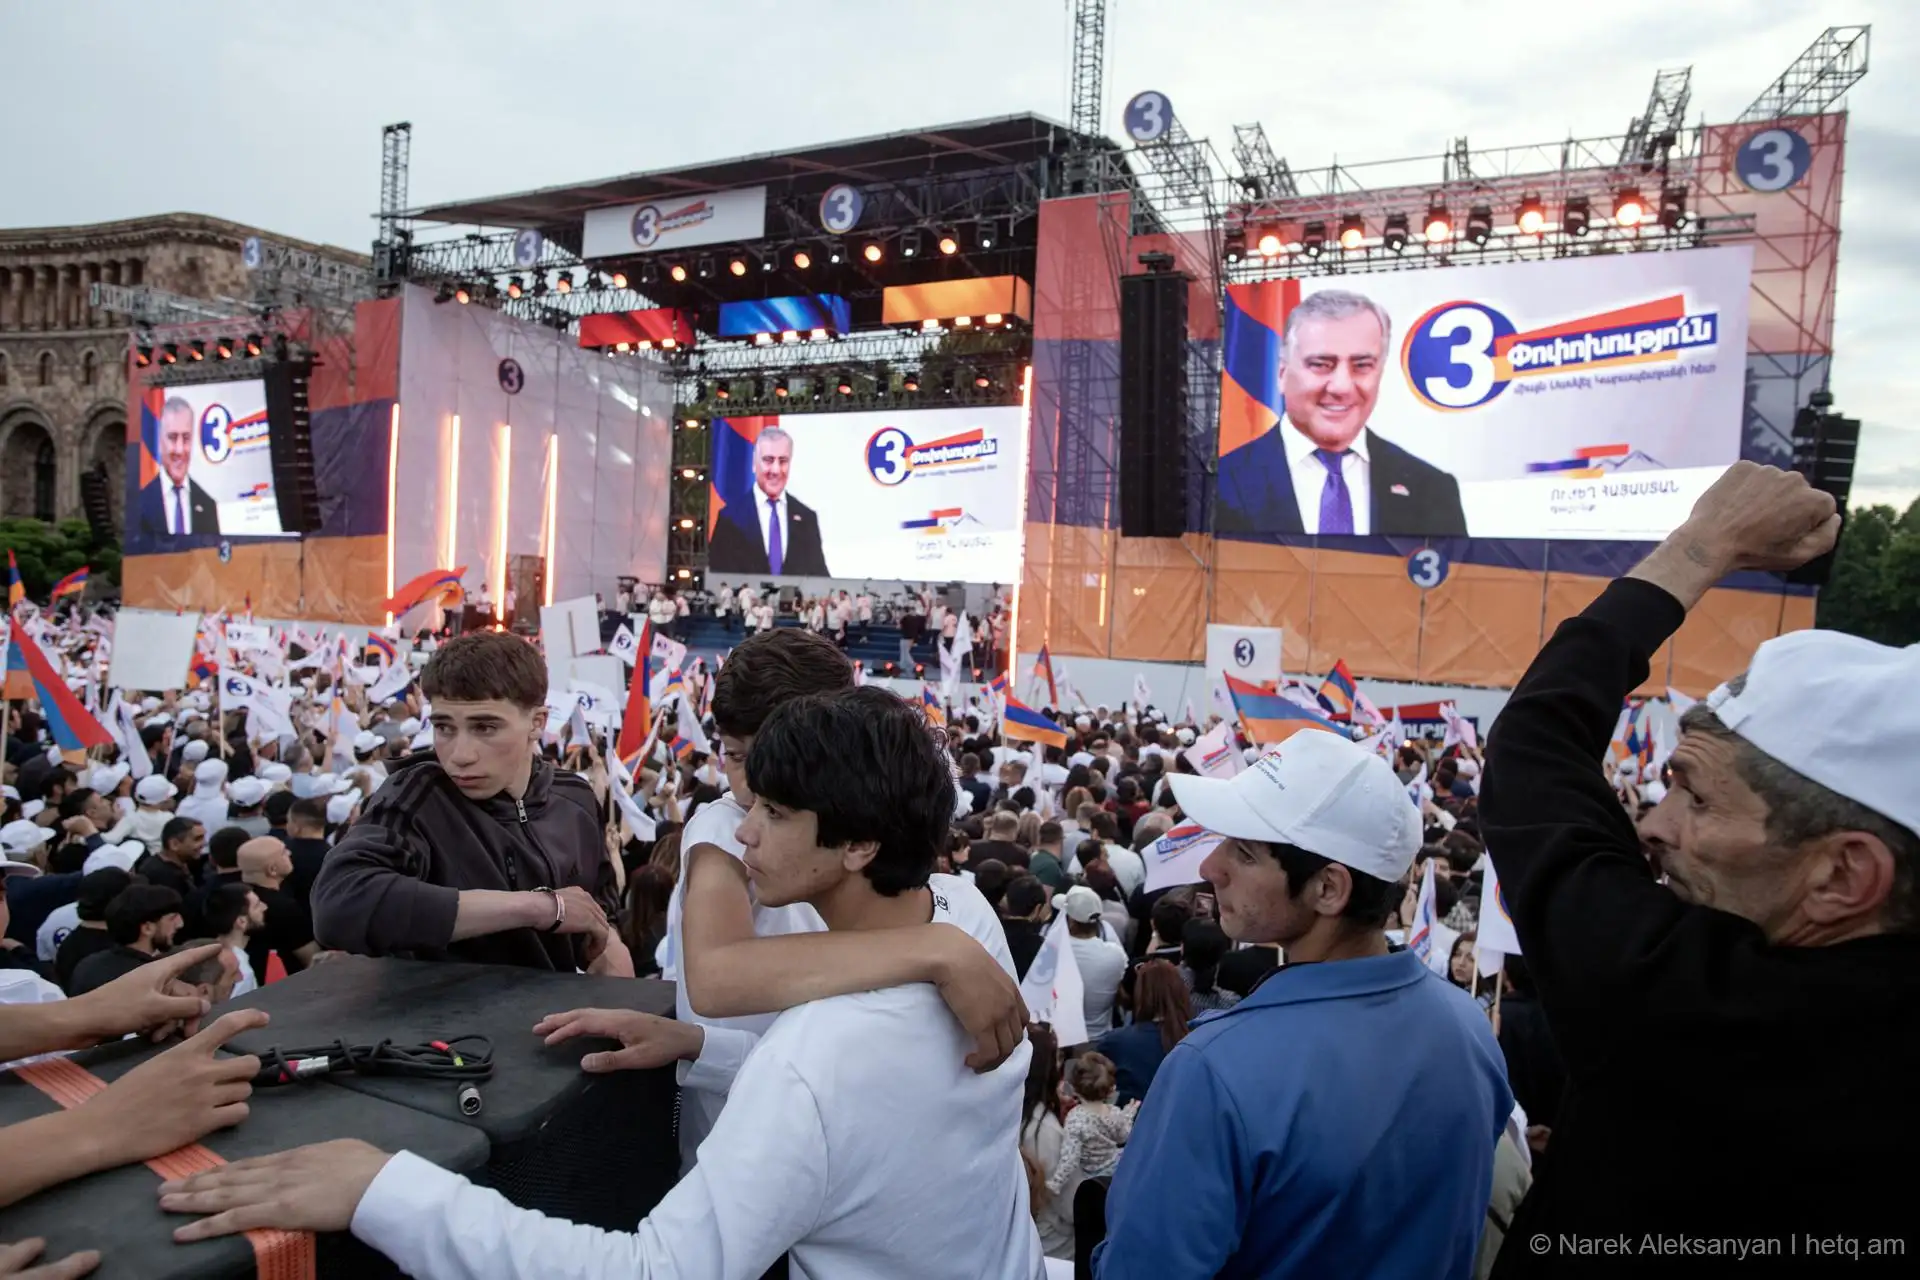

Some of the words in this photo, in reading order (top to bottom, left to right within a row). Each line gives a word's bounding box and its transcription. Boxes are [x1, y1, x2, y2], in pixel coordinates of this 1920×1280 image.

[1132, 93, 1164, 141] 3
[1747, 130, 1795, 191] 3
[637, 208, 658, 246] 3
[826, 186, 854, 232] 3
[245, 237, 260, 268] 3
[518, 231, 537, 268] 3
[502, 360, 519, 393] 3
[1425, 307, 1495, 407] 3
[204, 404, 229, 463] 3
[874, 429, 907, 485] 3
[1413, 550, 1440, 587] 3
[1238, 639, 1252, 666] 3
